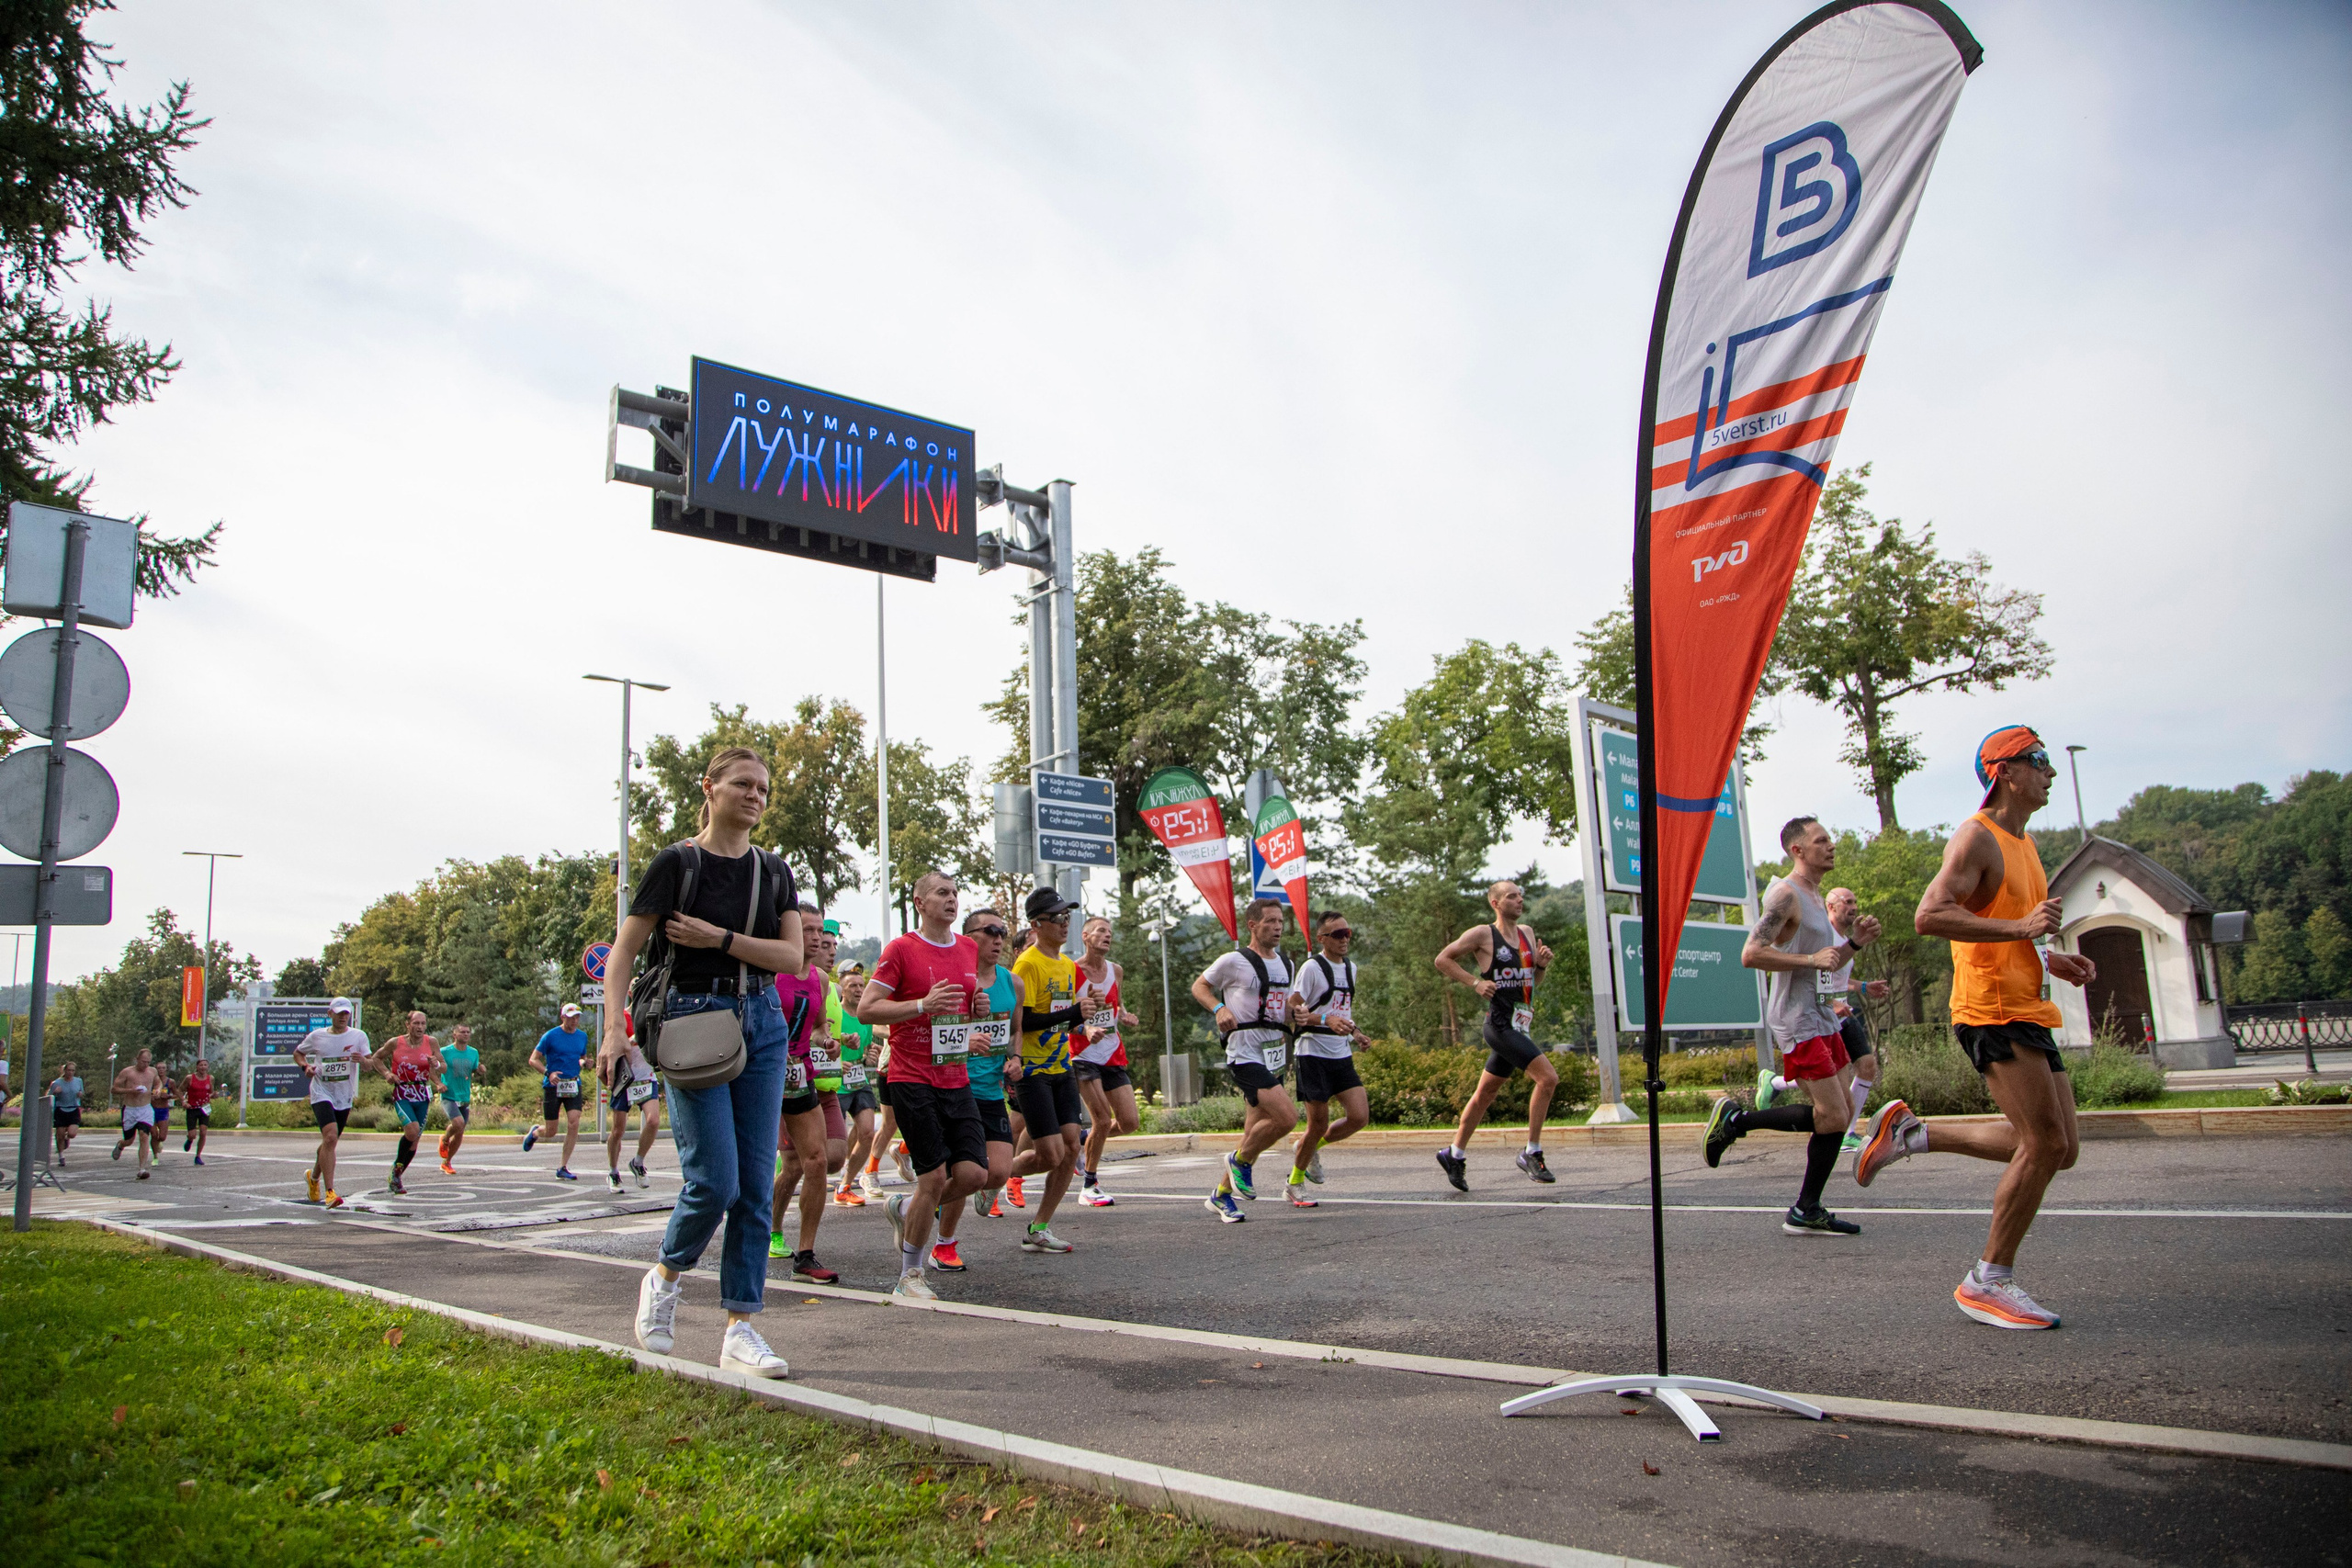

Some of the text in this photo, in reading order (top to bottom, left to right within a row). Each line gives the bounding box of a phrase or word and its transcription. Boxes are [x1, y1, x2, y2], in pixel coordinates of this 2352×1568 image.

[734, 392, 957, 462] ПОЛУМАРАФОН
[1711, 411, 1787, 446] 5verst.ru
[707, 415, 958, 536] ЛУЖНИКИ
[1675, 507, 1768, 539] ОФИЦИАЛЬНЫЙ ПАРТНЕР
[1699, 598, 1714, 608] ОАО
[1619, 753, 1638, 769] Мала
[1049, 778, 1065, 786] Кафе
[1050, 786, 1062, 795] Cafe
[1624, 794, 1635, 807] P6
[1052, 839, 1067, 847] Кафе
[1052, 848, 1064, 856] Cafe
[1678, 949, 1722, 964] спортцентр
[1678, 966, 1699, 978] Center
[325, 1063, 347, 1073] 2875
